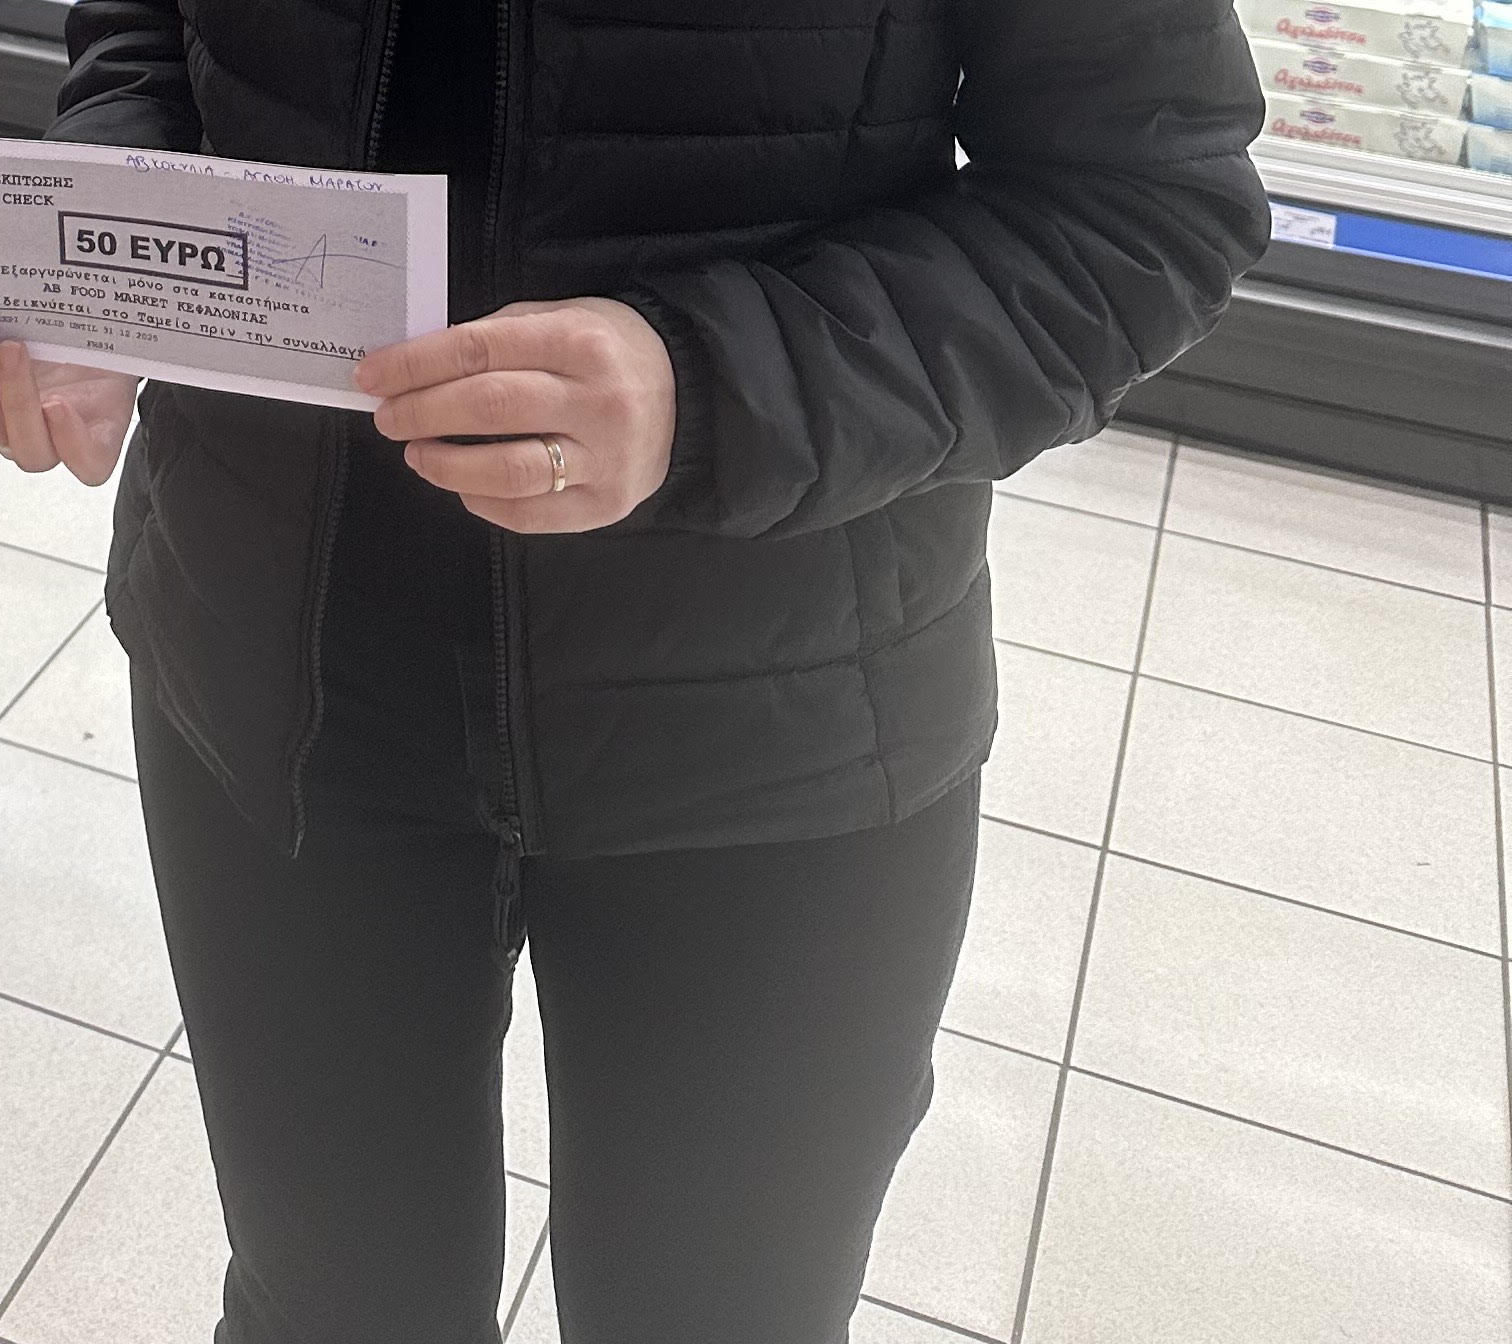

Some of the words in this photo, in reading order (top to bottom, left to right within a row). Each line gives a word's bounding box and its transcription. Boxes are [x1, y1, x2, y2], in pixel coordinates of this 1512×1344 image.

[2, 193, 55, 206] CHECK
[76, 229, 118, 256] 50
[130, 234, 226, 272] ΕΥΡΩ
[0, 265, 117, 284] Εξαργυρώνεται
[128, 277, 164, 291] μόνο
[173, 285, 199, 297] στα
[209, 290, 310, 314] καταστήματα
[70, 285, 106, 299] FOOD
[114, 291, 169, 309] MARKET
[177, 302, 268, 325] ΚΕΦΑΛΟΝΙΑΣ
[102, 308, 129, 320] στο
[137, 314, 190, 331] Ταμείο
[199, 324, 236, 338] πριν
[246, 331, 273, 345] την
[283, 337, 366, 359] συναλλαγή
